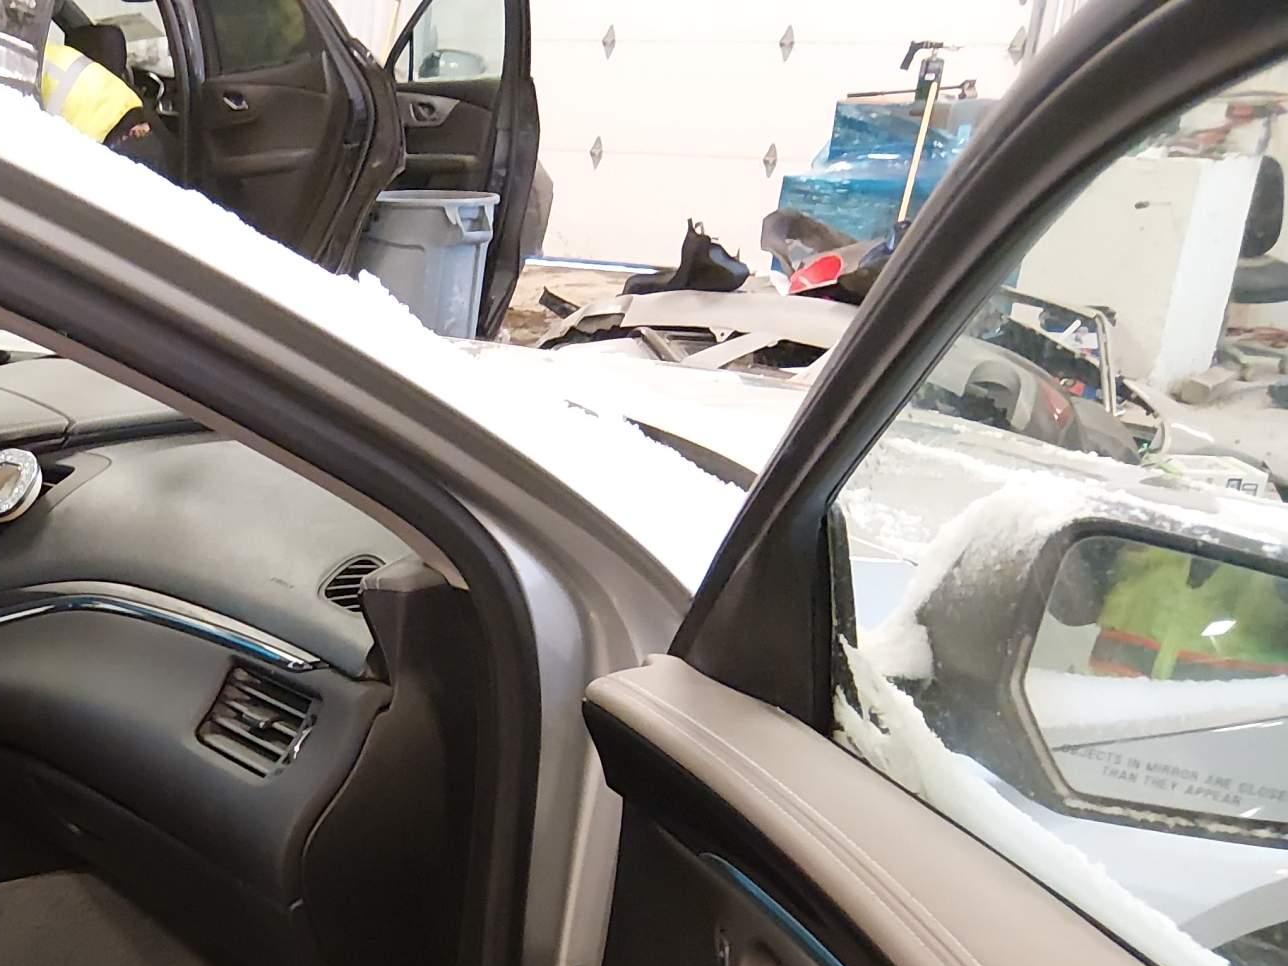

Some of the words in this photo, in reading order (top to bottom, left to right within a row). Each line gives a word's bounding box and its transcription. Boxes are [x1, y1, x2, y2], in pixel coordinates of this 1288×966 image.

[1102, 766, 1137, 784] THAN
[1143, 775, 1177, 791] THEY
[1184, 785, 1241, 806] APPEAR
[1127, 757, 1140, 770] IN
[1145, 761, 1198, 781] MIRROR
[1203, 775, 1232, 790] ARE
